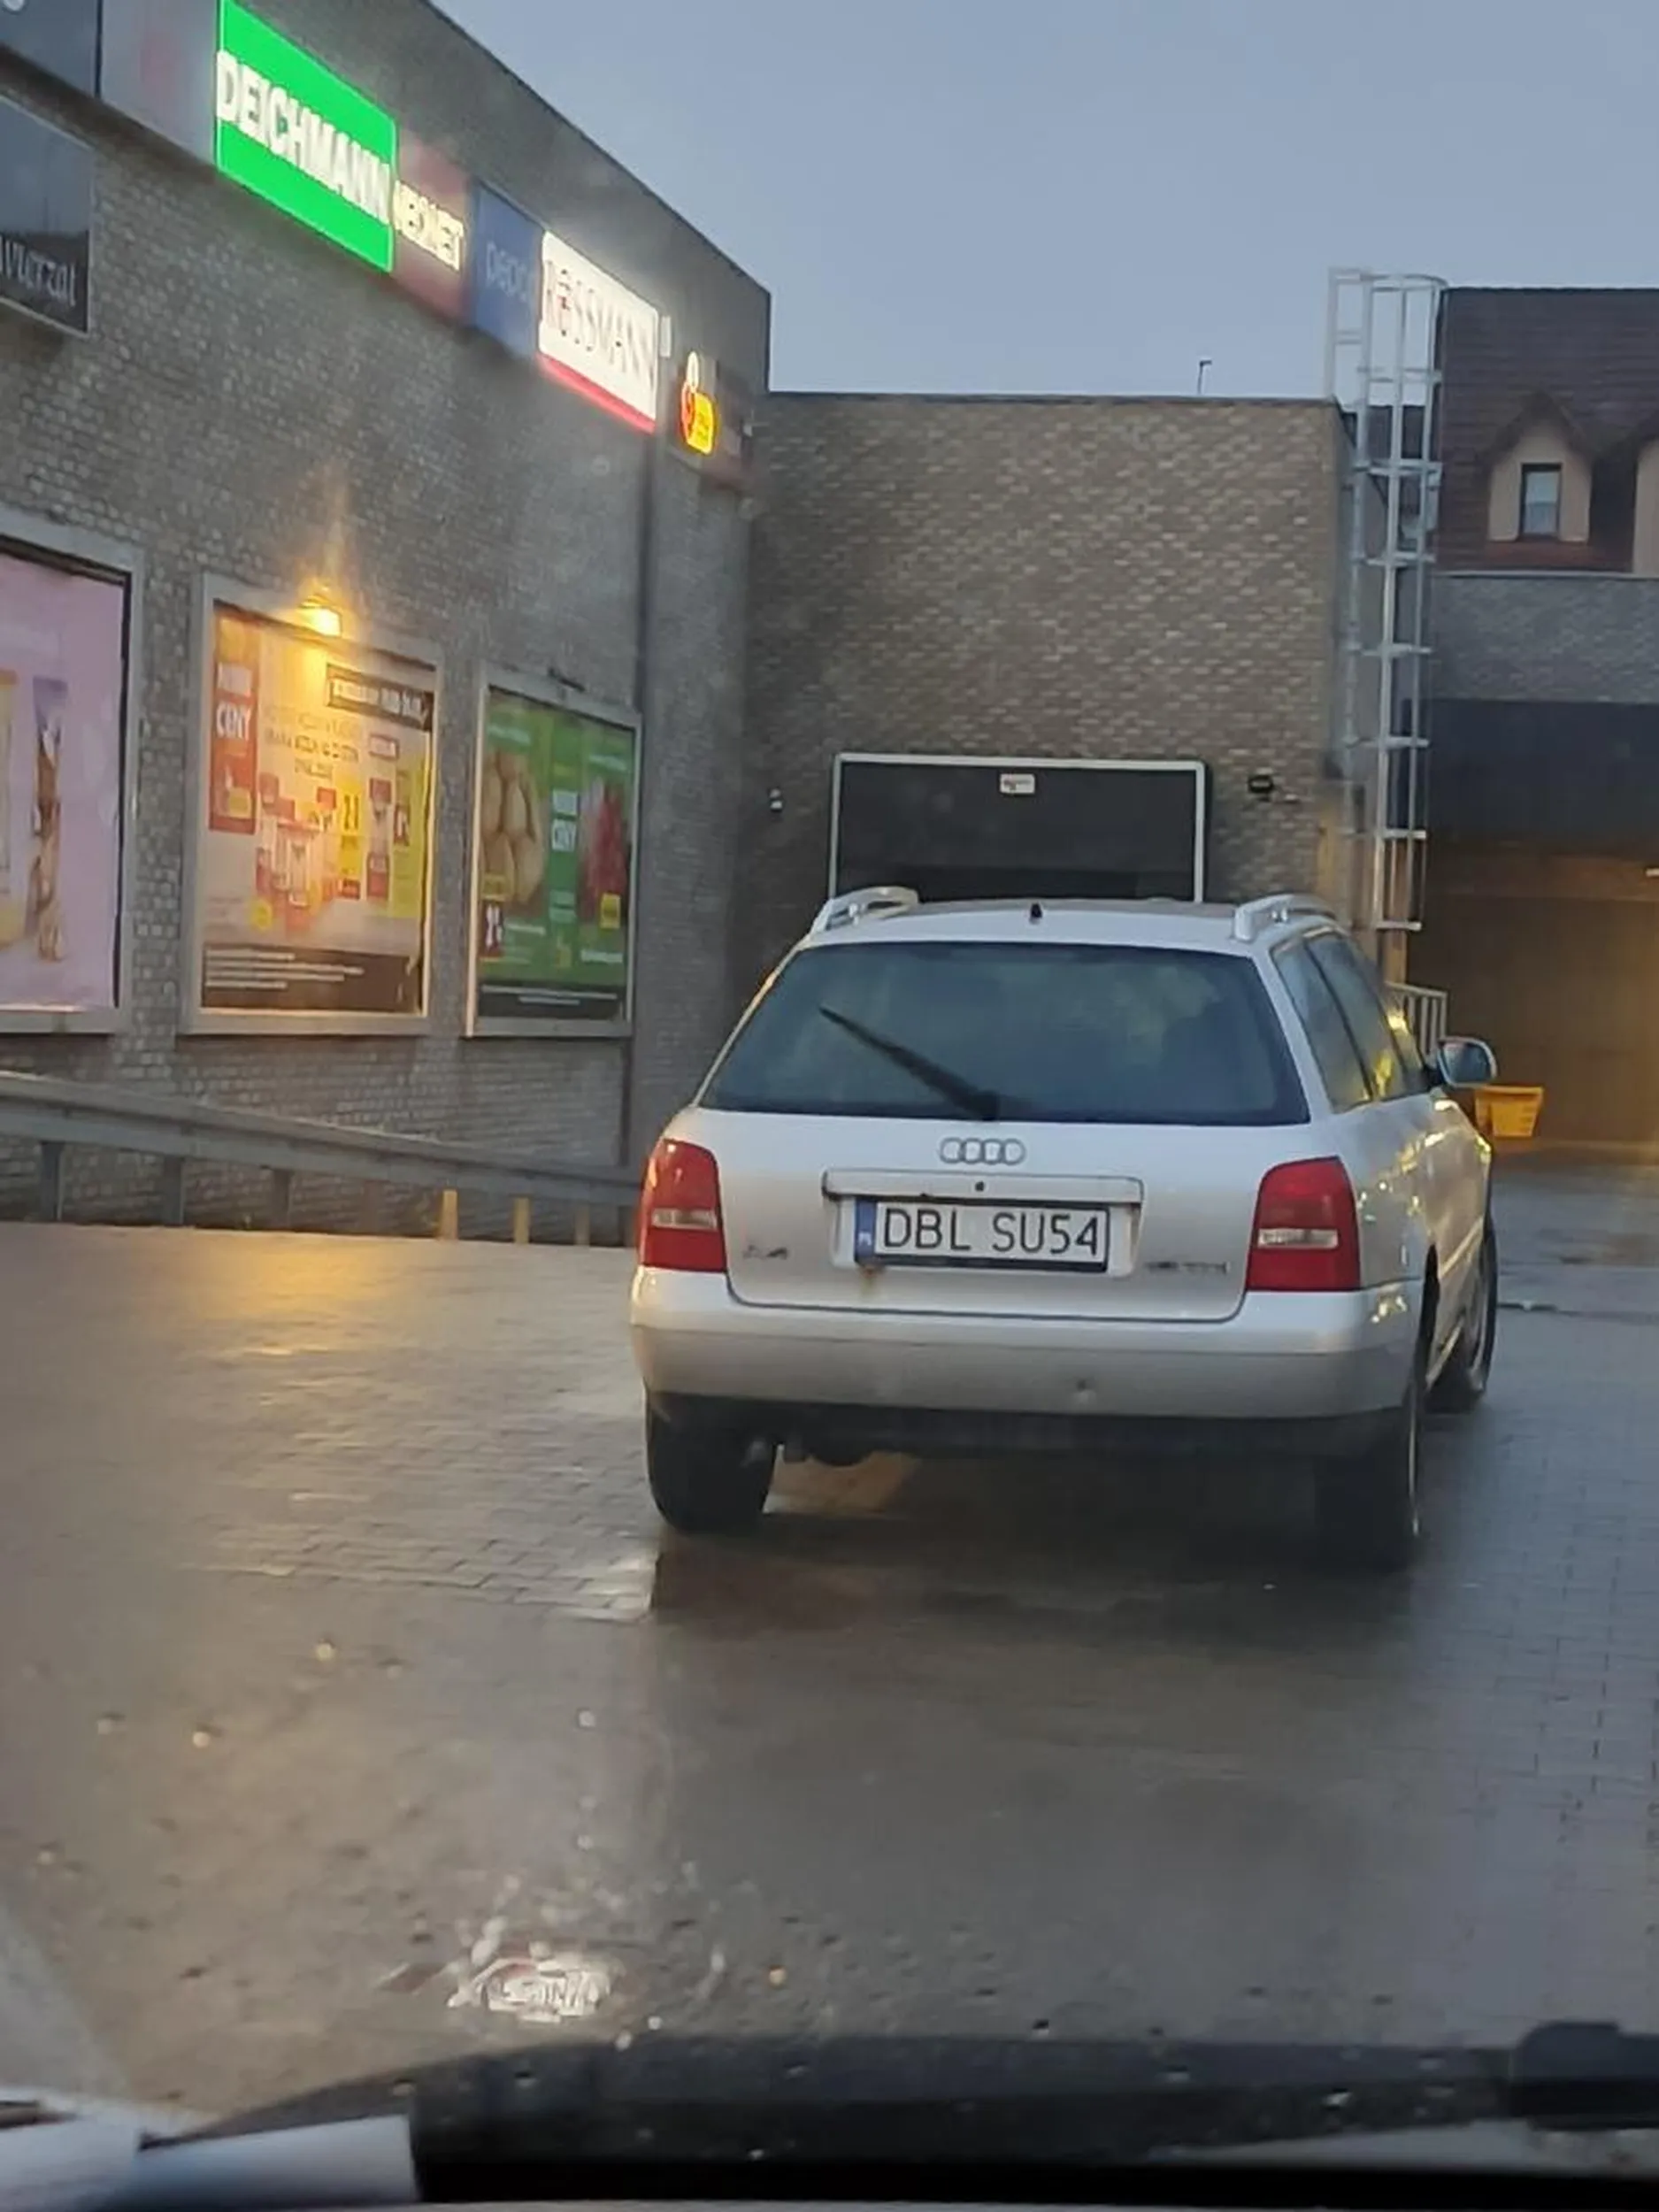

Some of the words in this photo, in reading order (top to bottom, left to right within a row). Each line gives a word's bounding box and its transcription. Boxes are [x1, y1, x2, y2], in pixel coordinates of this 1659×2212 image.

[216, 50, 390, 225] DEICHMANN
[884, 1208, 972, 1249] DBL
[992, 1211, 1100, 1256] SU54
